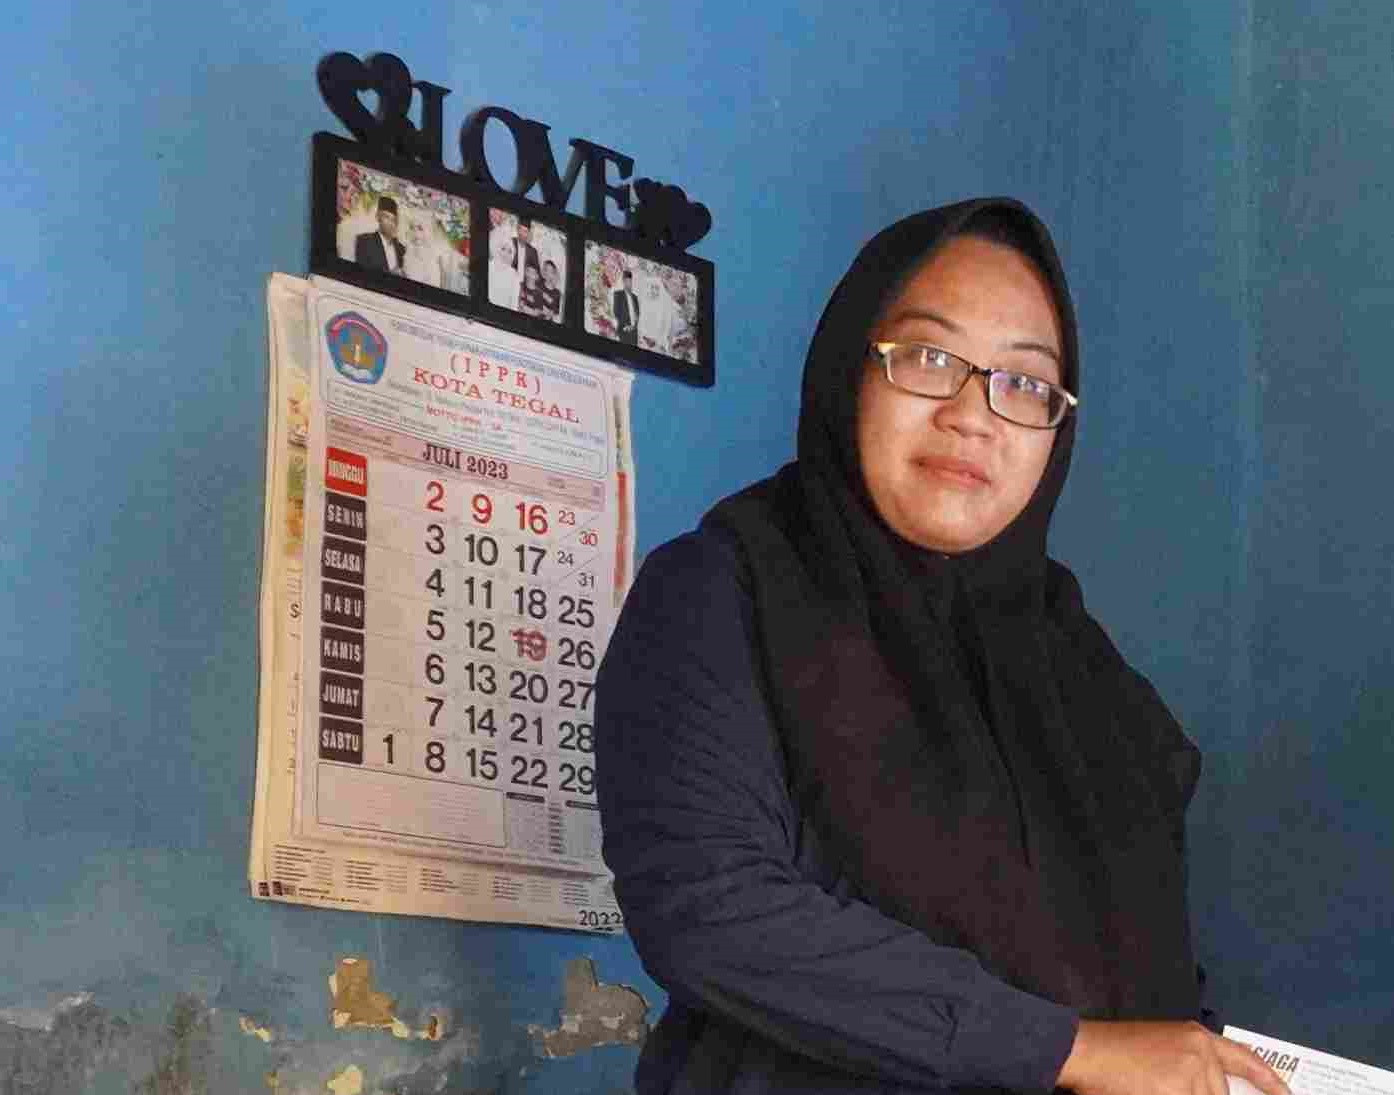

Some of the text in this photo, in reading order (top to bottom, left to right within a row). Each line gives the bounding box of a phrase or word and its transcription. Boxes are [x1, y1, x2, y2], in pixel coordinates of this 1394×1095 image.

[411, 81, 635, 234] LOVE
[414, 366, 483, 400] KOTA
[492, 388, 580, 424] TEGAL
[423, 443, 509, 480] JULI 2023
[425, 480, 446, 513] 2
[471, 493, 494, 525] 9
[515, 501, 549, 535] 16
[558, 509, 576, 527] 23
[425, 523, 446, 555] 3
[464, 534, 499, 567] 10
[515, 543, 548, 576] 17
[556, 550, 574, 566] 24
[577, 571, 595, 589] 31
[425, 568, 446, 597] 4
[464, 575, 494, 609] 11
[514, 586, 547, 620] 18
[557, 595, 595, 629] 25
[425, 610, 446, 641] 5
[464, 619, 496, 652] 12
[557, 637, 596, 671] 26
[322, 639, 597, 711] KAMIS 6 13 20 27
[321, 685, 597, 754] JUMAT 7 14 21 28
[320, 729, 598, 796] SABTU 1 8 15 22 29
